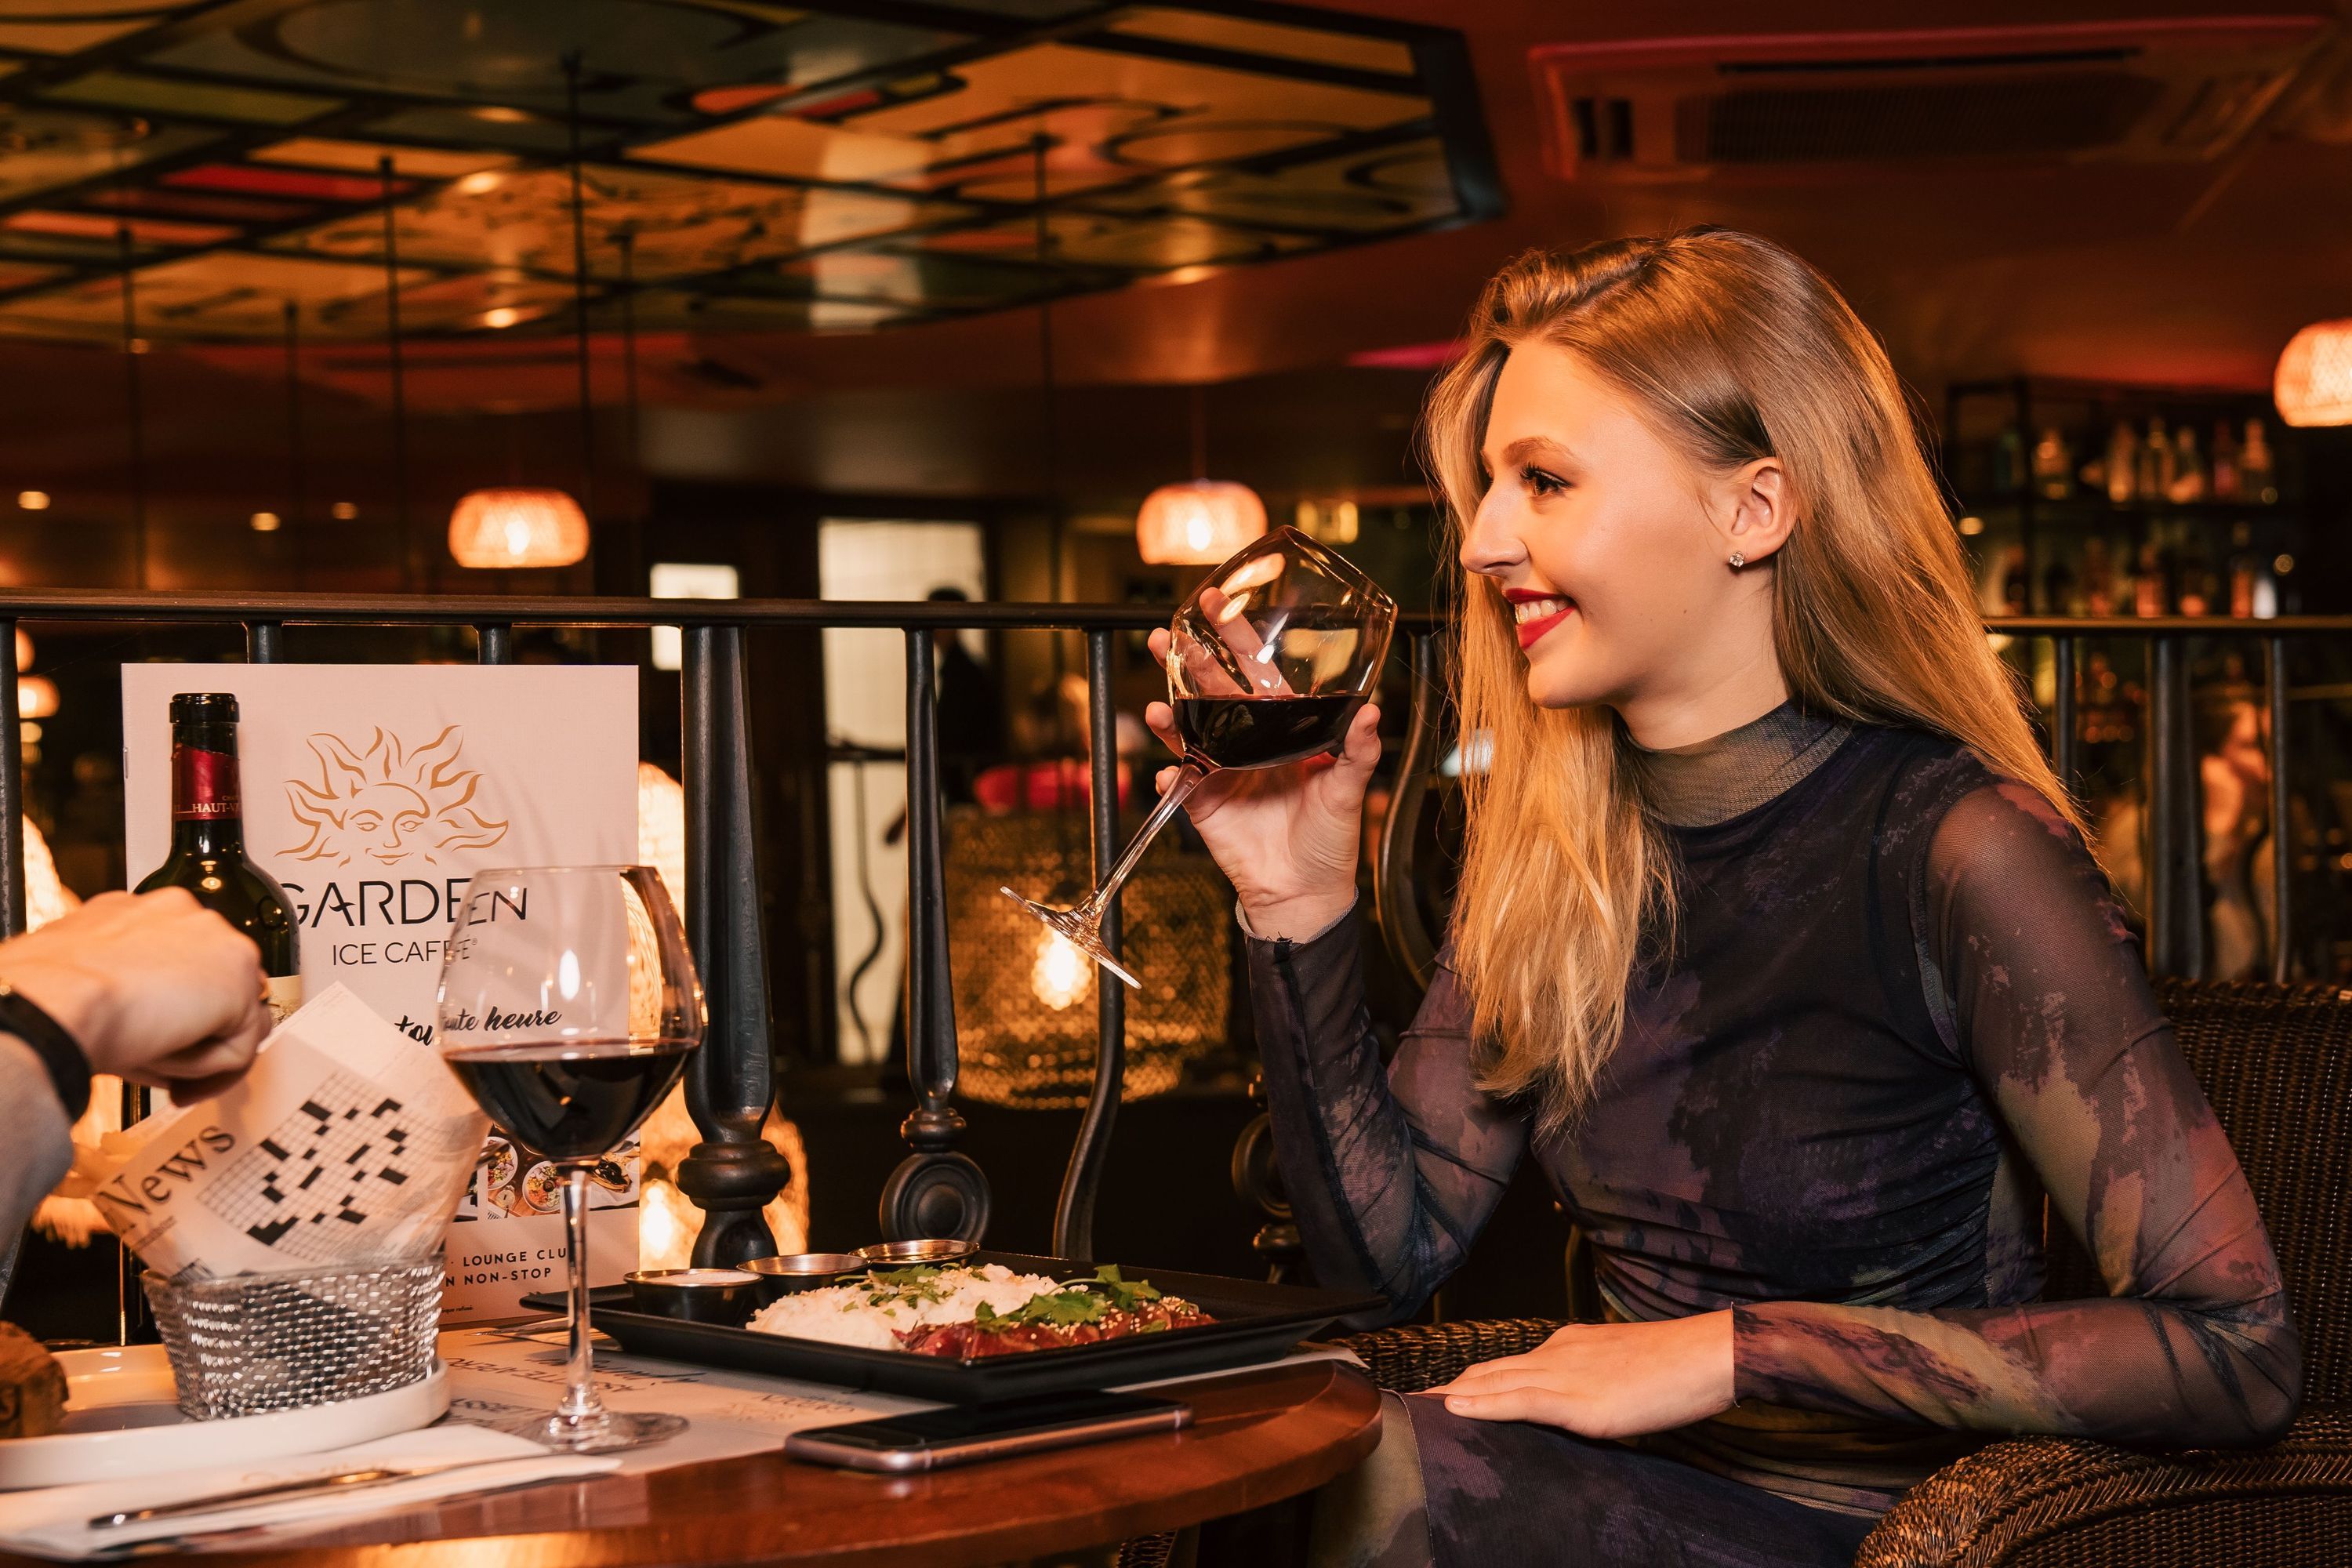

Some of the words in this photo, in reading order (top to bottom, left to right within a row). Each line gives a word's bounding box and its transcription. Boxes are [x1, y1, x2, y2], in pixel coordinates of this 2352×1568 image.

[332, 942, 377, 966] ICE
[484, 1006, 562, 1032] heure
[97, 1125, 236, 1215] News
[463, 1250, 528, 1267] LOUNGE
[536, 1247, 567, 1261] CLU
[463, 1267, 552, 1286] NON-STOP
